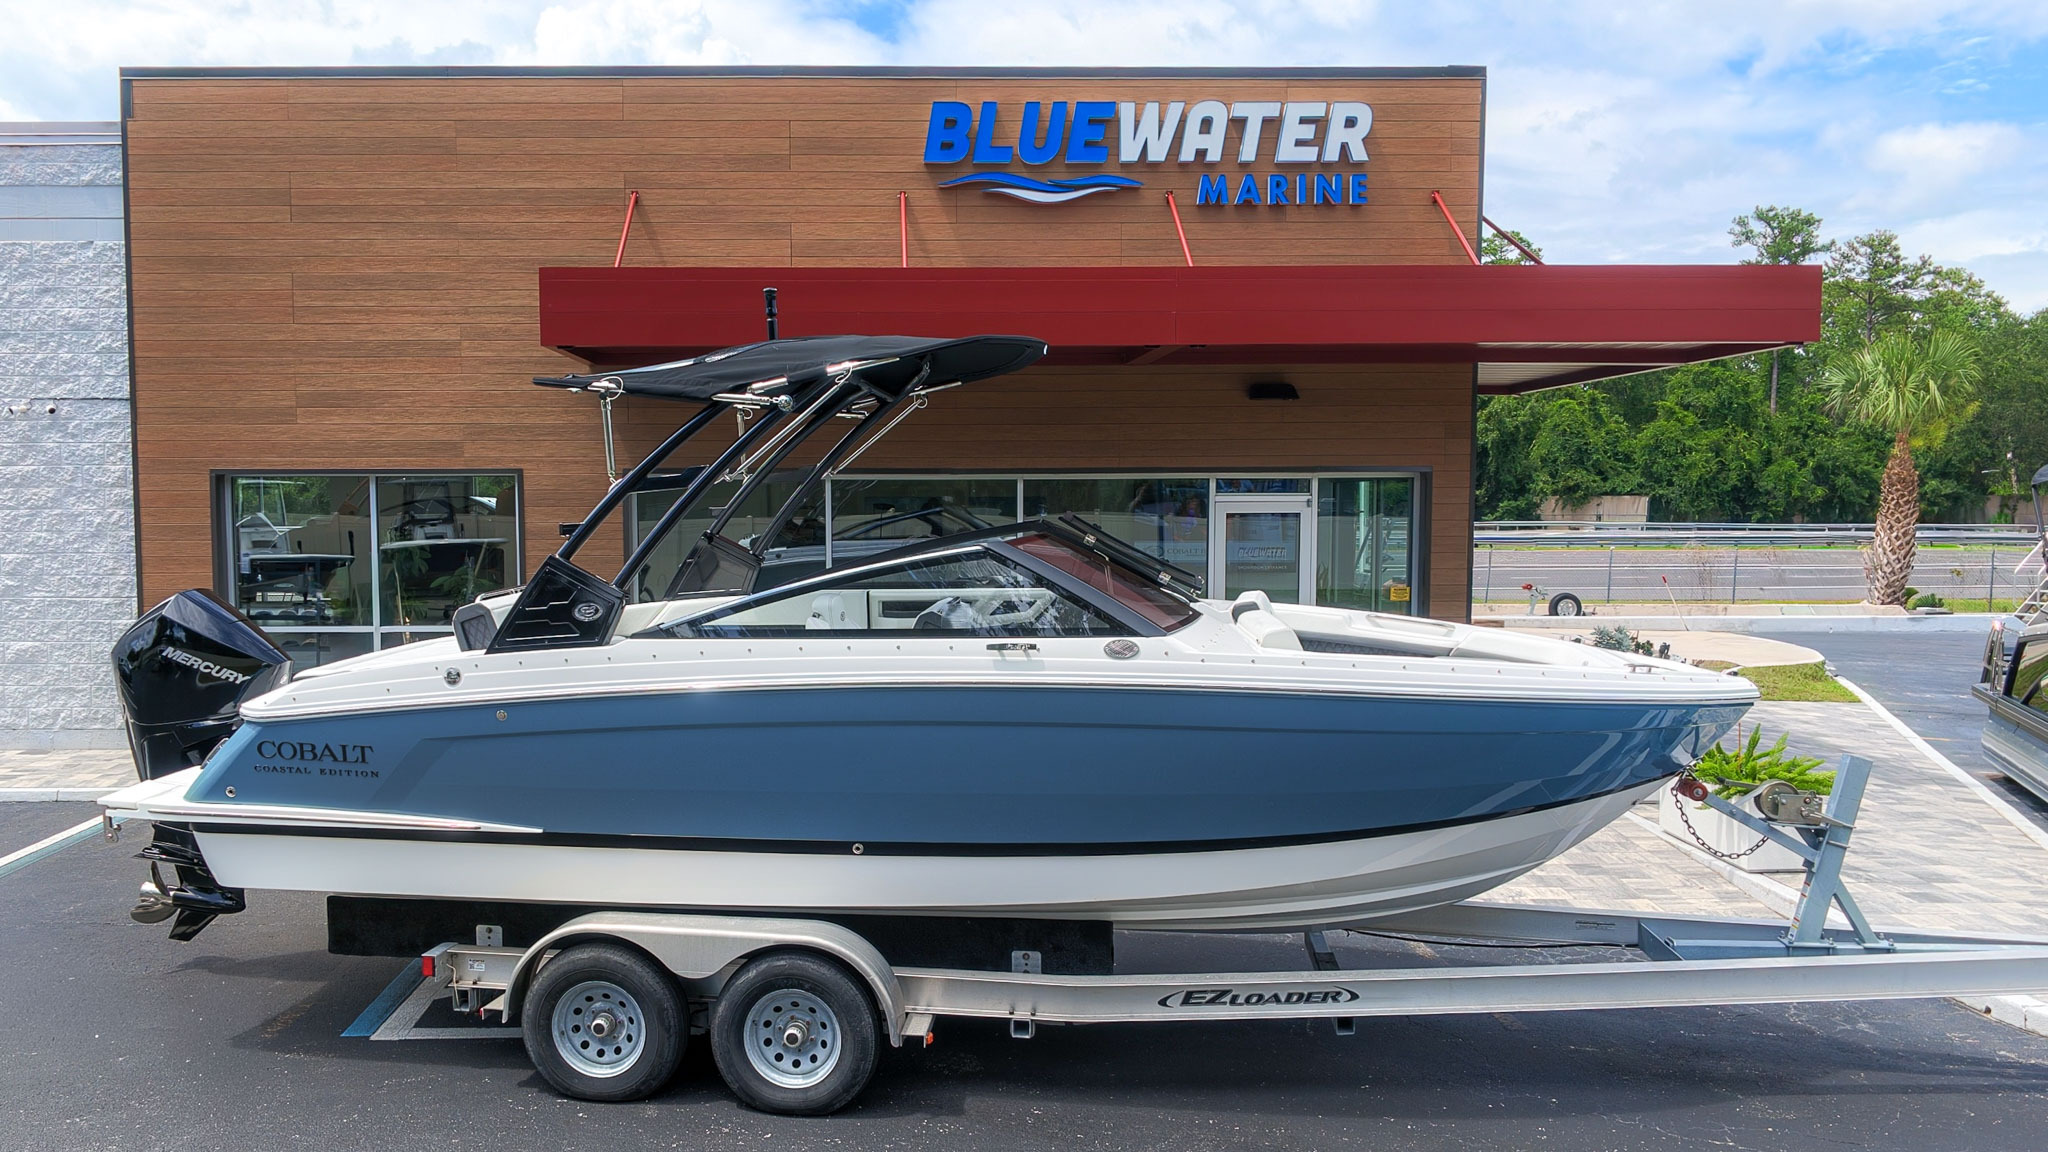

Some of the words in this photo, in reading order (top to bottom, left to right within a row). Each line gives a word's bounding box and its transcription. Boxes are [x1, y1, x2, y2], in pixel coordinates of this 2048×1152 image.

[923, 100, 1374, 165] BLUEWATER
[1196, 173, 1368, 206] MARINE
[162, 646, 251, 685] MERCURY
[256, 740, 375, 765] COBALT
[254, 765, 312, 775] COASTAL
[319, 768, 380, 778] EDITION
